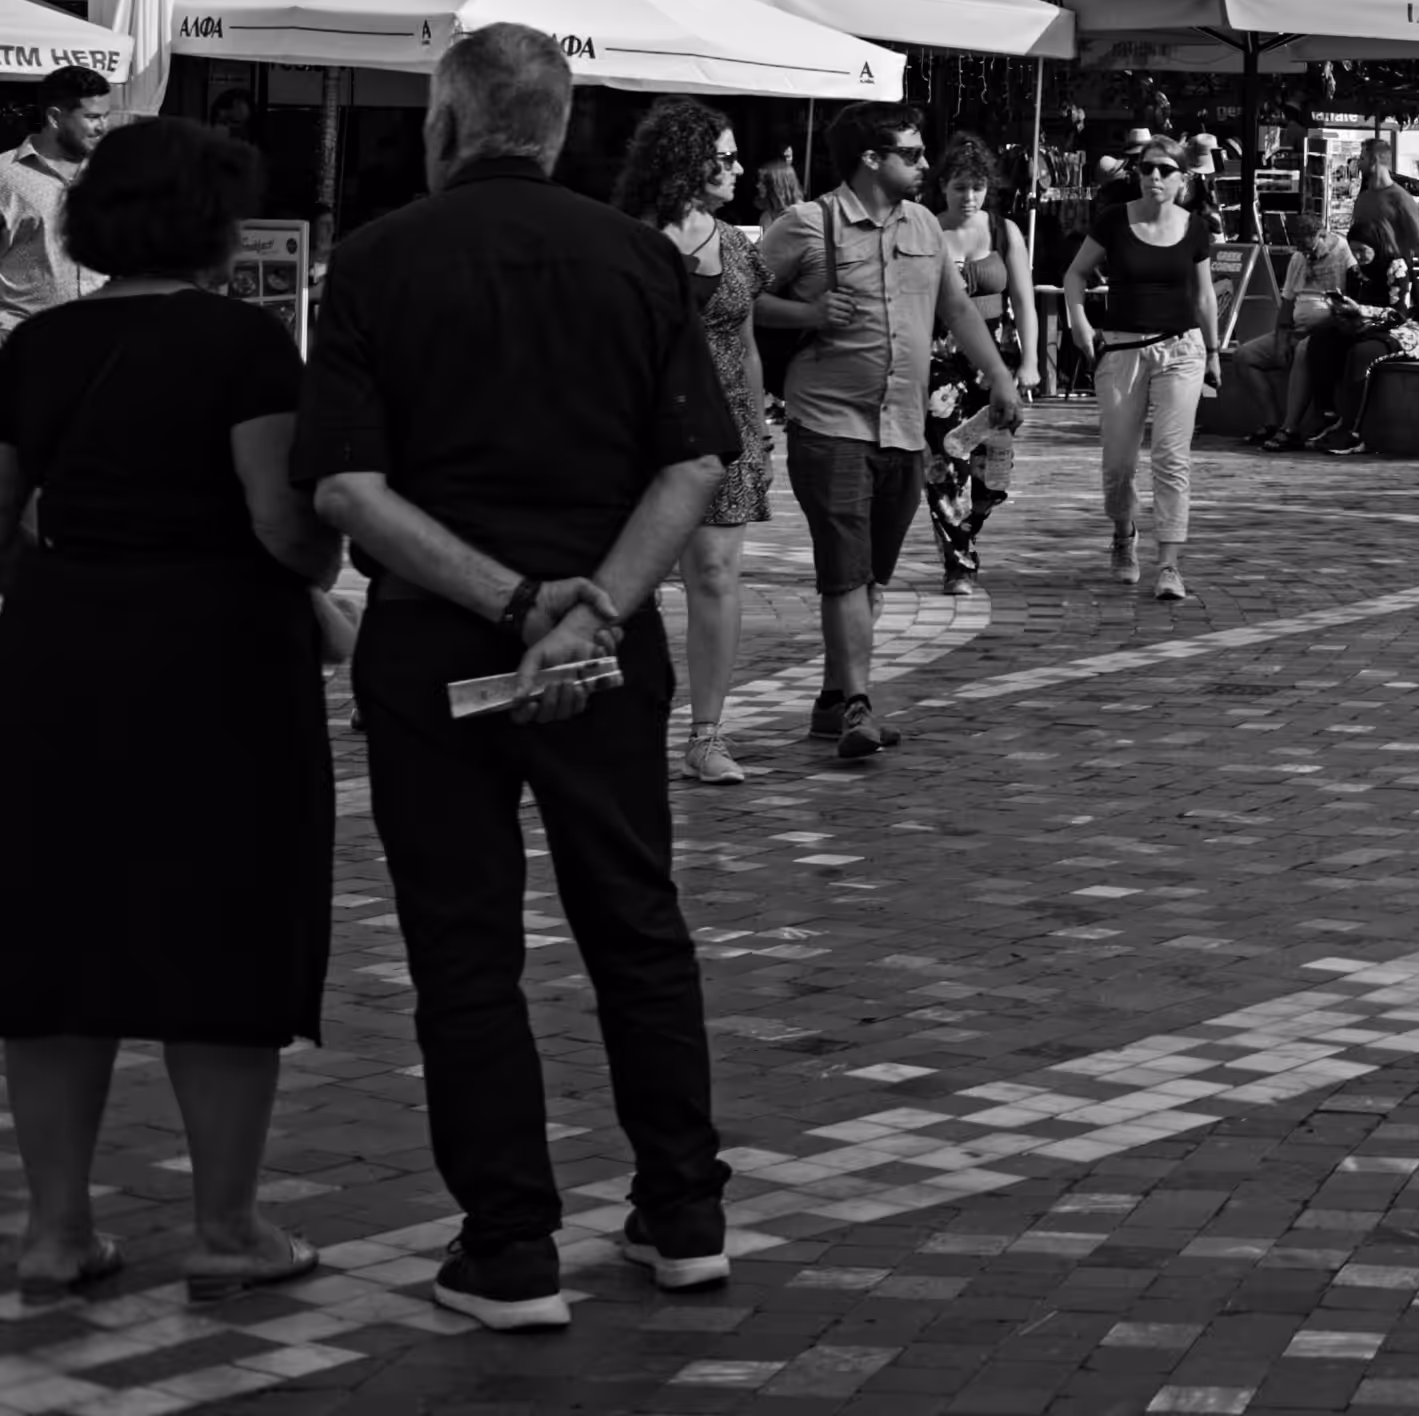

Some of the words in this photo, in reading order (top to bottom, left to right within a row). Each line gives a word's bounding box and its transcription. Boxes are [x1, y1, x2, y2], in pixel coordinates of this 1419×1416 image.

[180, 16, 223, 38] ΑΛΦΑ
[0, 45, 42, 66] TM
[51, 48, 120, 72] HERE
[552, 34, 596, 59] ΦΑ
